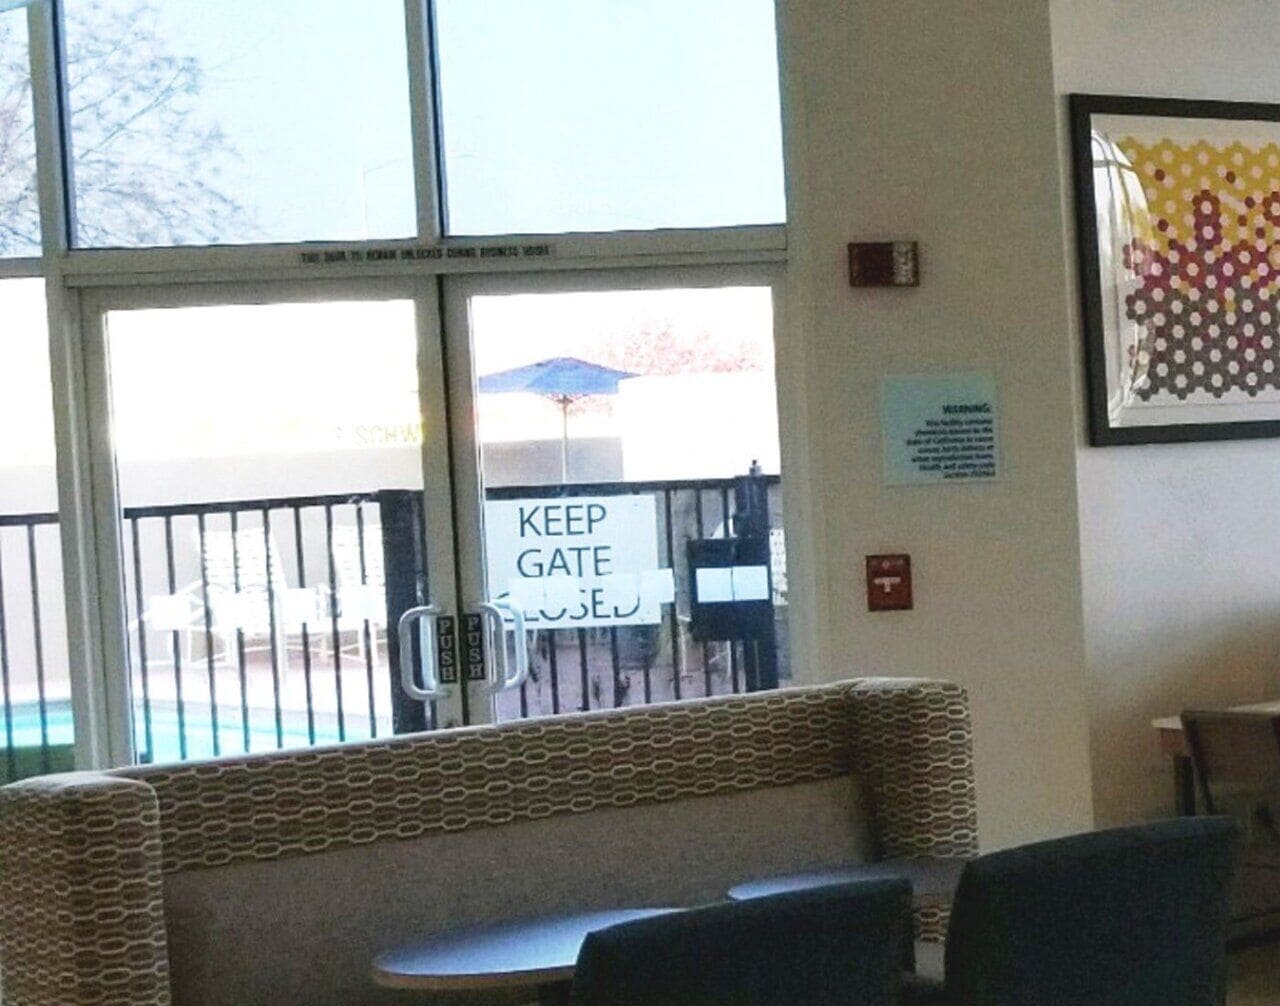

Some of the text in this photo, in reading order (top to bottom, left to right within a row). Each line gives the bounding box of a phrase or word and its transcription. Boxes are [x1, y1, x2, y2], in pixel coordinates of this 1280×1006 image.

[518, 503, 607, 538] KEEP
[516, 545, 613, 578] GATE
[496, 588, 641, 623] LSED
[439, 618, 455, 681] PUSH
[466, 616, 483, 679] PUSH
